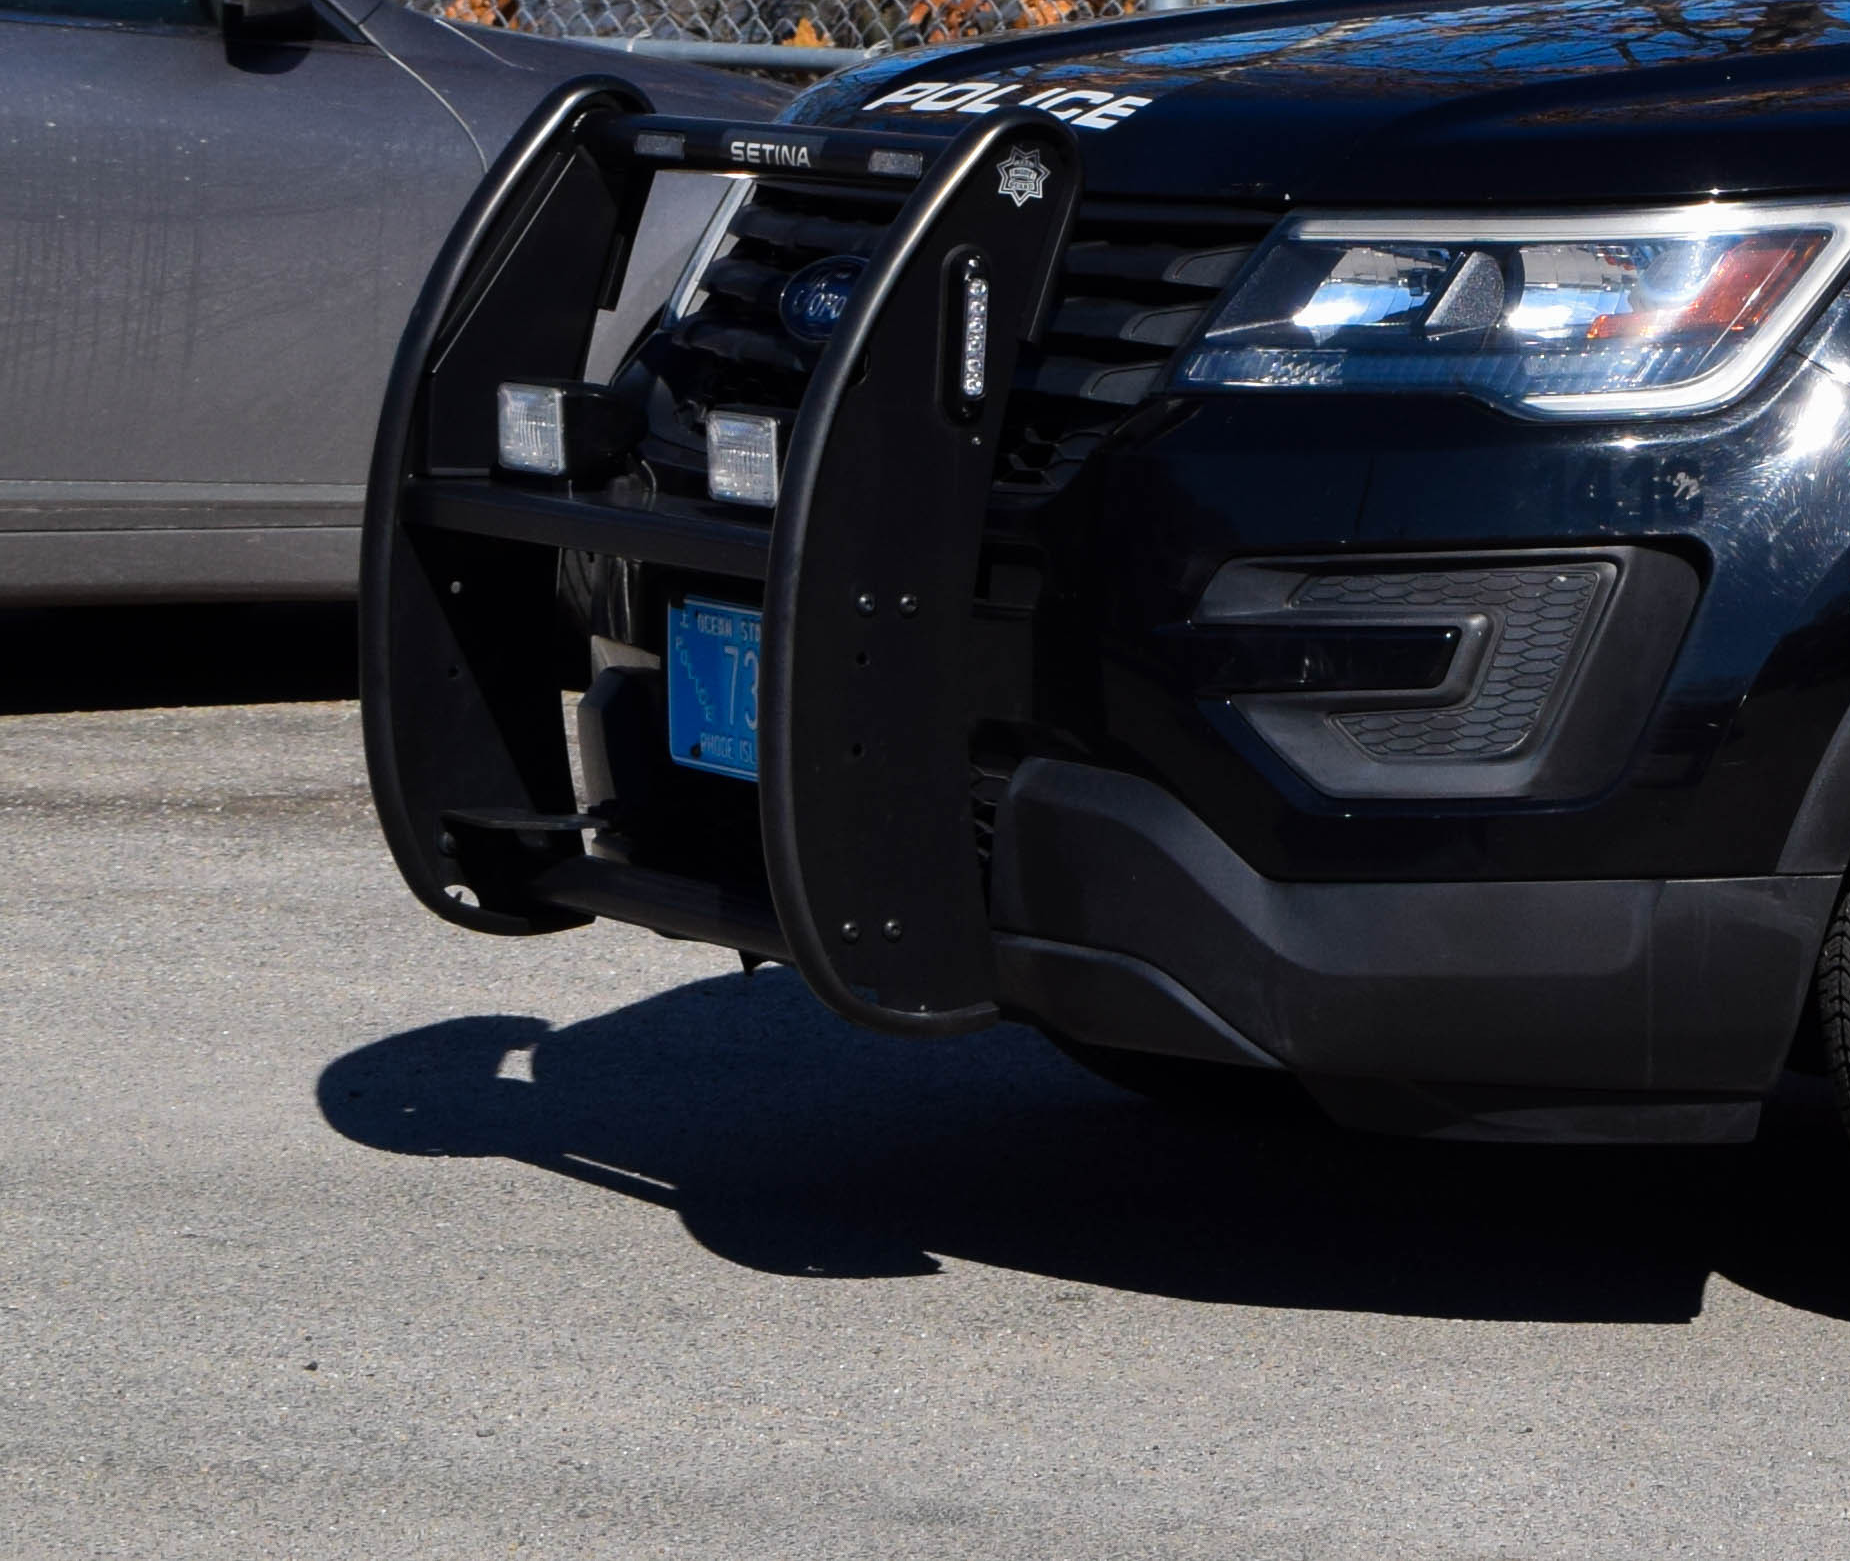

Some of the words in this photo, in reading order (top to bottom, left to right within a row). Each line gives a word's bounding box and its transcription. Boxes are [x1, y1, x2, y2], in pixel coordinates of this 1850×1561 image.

[862, 82, 1153, 130] POLICE
[730, 141, 812, 168] SETINA
[697, 613, 733, 639] OCEAN
[700, 732, 735, 761] RHODE
